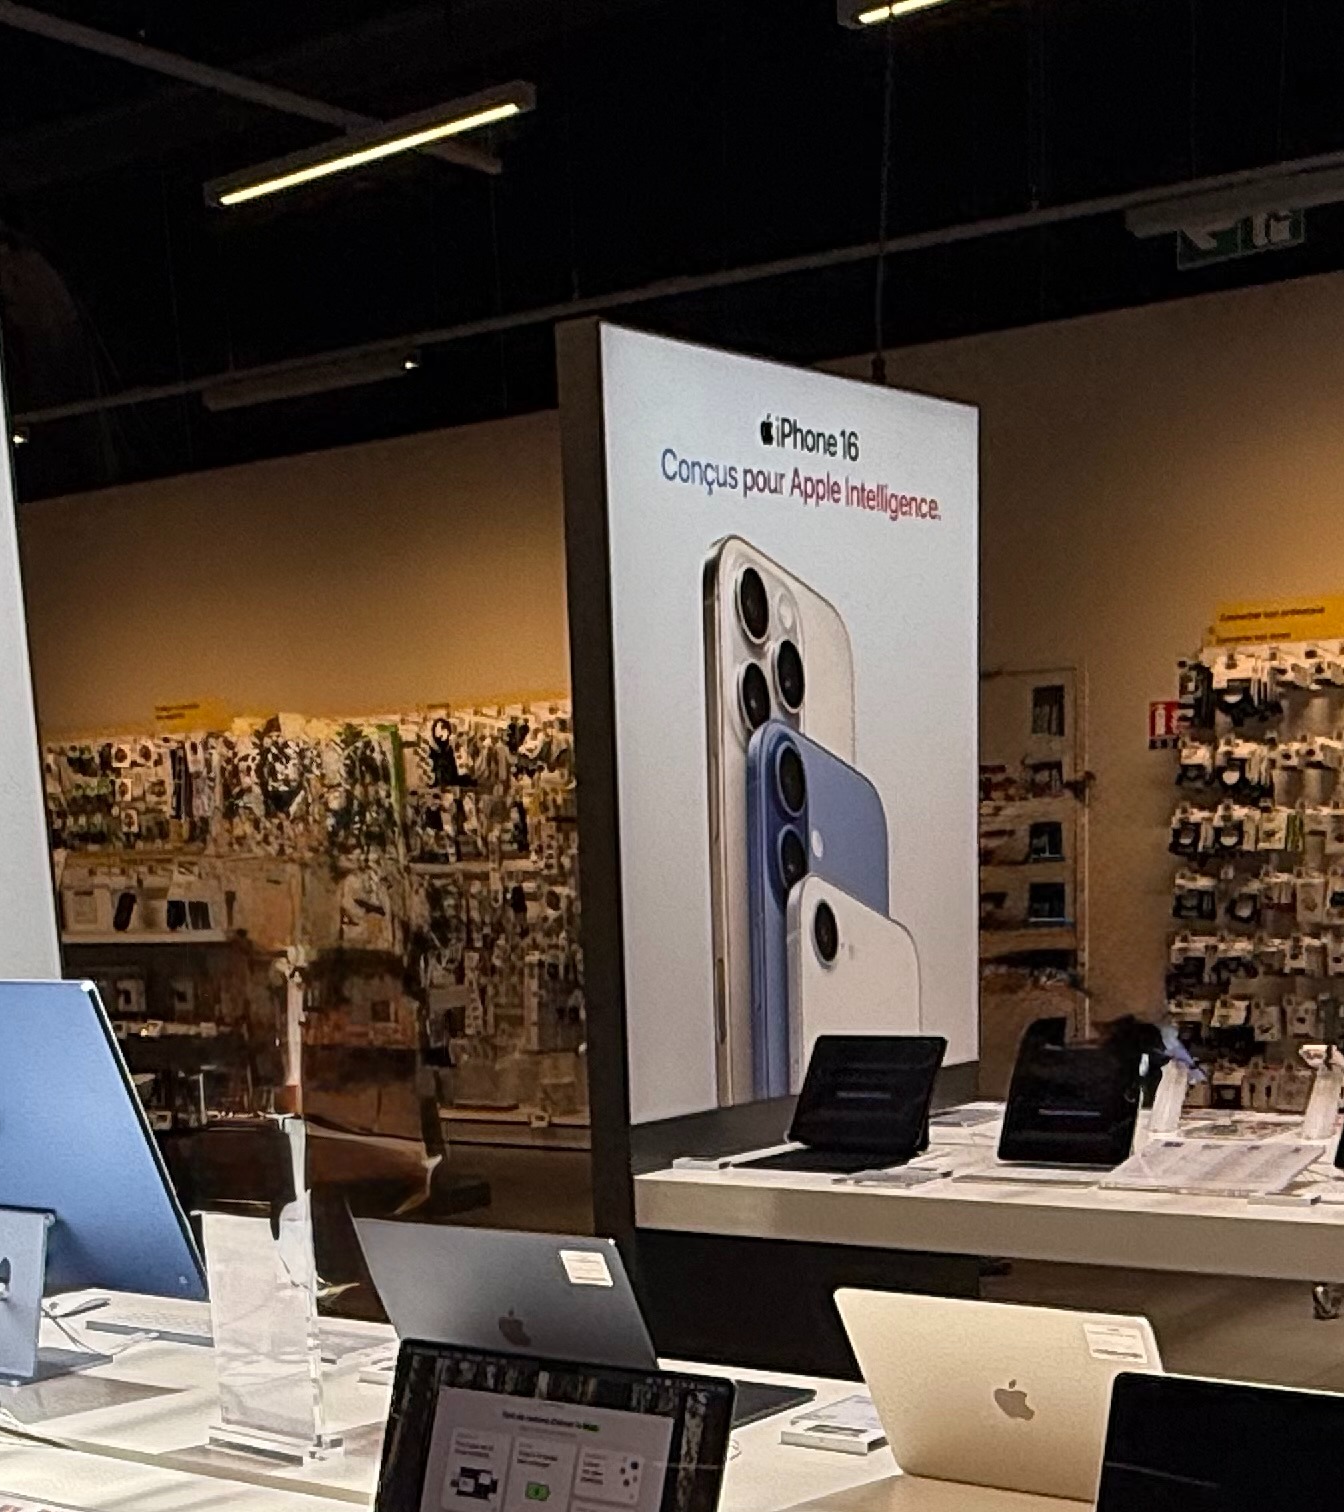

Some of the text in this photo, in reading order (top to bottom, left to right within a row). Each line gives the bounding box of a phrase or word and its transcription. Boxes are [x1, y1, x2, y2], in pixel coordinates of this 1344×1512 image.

[775, 417, 859, 461] iPhone 16
[661, 448, 942, 521] Conçus pour Apple Intelligence.
